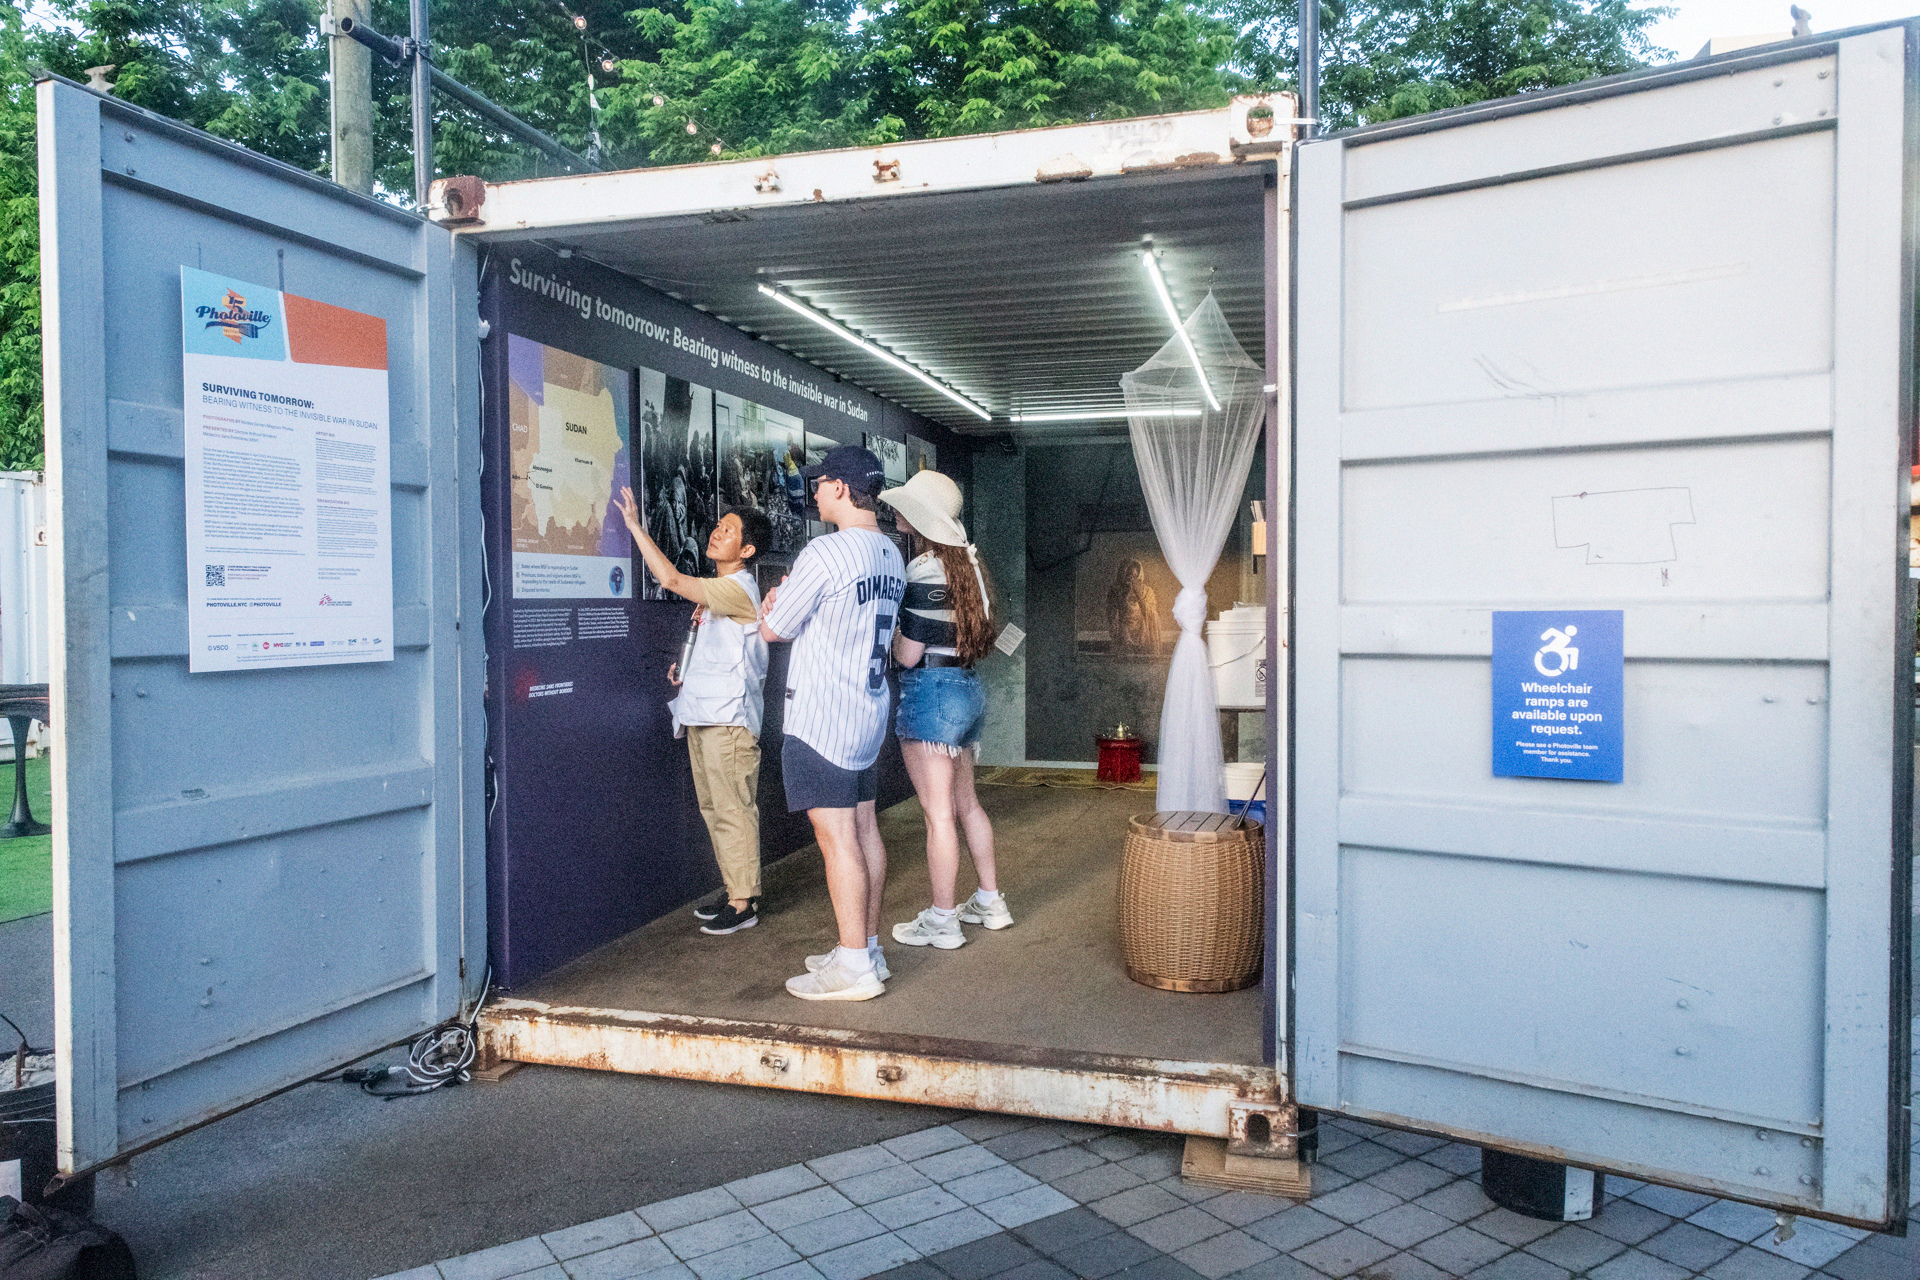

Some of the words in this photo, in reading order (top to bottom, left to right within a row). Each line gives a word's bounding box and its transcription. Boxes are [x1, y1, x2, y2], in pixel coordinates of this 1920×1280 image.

[195, 306, 271, 322] Photoville
[509, 258, 591, 319] Surviving
[596, 297, 669, 343] tomorrow:
[673, 327, 718, 368] Bearing
[722, 350, 759, 378] witness
[761, 365, 771, 383] to
[773, 369, 787, 390] the
[789, 375, 822, 404] invisible
[824, 393, 837, 409] war
[839, 396, 845, 411] in
[848, 400, 868, 422] Sudan
[202, 382, 257, 399] SURVIVING
[258, 392, 314, 409] TOMORROW:
[202, 395, 237, 408] BEARING
[239, 401, 272, 413] WITNESS
[273, 406, 283, 414] TO
[284, 408, 298, 417] THE
[300, 410, 331, 422] INVISIBLE
[332, 416, 347, 424] WAR
[348, 418, 355, 426] IN
[356, 420, 377, 430] SUDAN
[512, 423, 528, 433] CHAD
[566, 422, 587, 434] SUDAN
[869, 614, 893, 689] 5
[1521, 682, 1592, 694] Wheelchair
[1525, 697, 1565, 709] ramps
[1567, 698, 1588, 707] are
[1512, 709, 1567, 720] available
[1570, 712, 1602, 723] upon
[1531, 724, 1582, 736] request.
